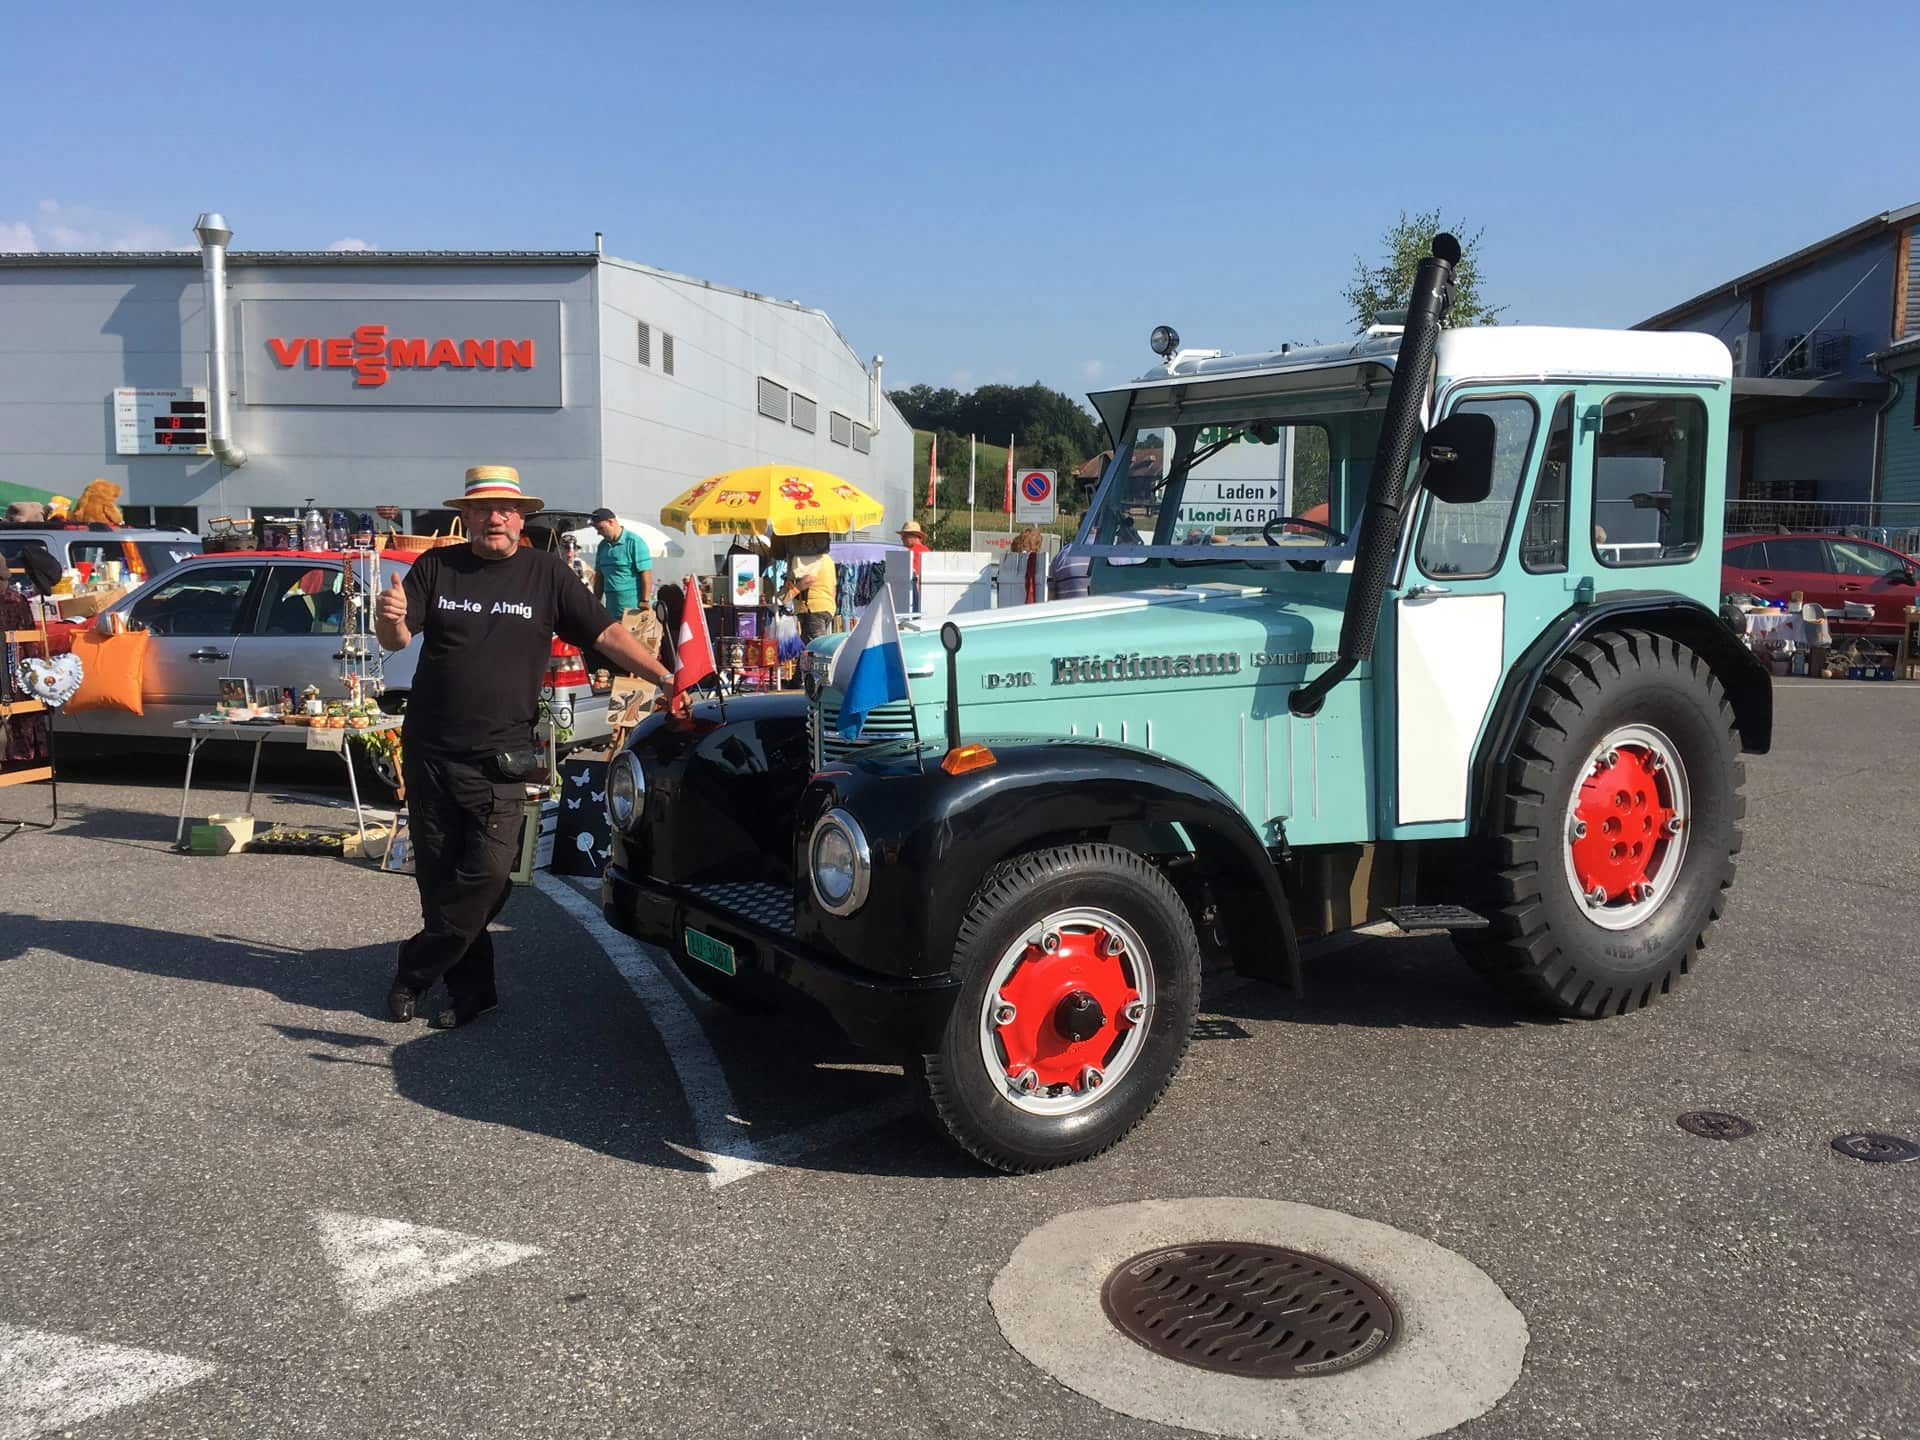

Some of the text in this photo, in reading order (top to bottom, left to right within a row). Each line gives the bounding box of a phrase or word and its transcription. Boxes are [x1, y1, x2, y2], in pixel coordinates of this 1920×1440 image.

[268, 324, 534, 386] VIESSMANN
[1217, 483, 1264, 500] Laden
[1188, 507, 1231, 522] Landi
[490, 601, 533, 619] Ahnig
[986, 671, 1033, 690] D-310
[1050, 651, 1242, 686] Hürlimann
